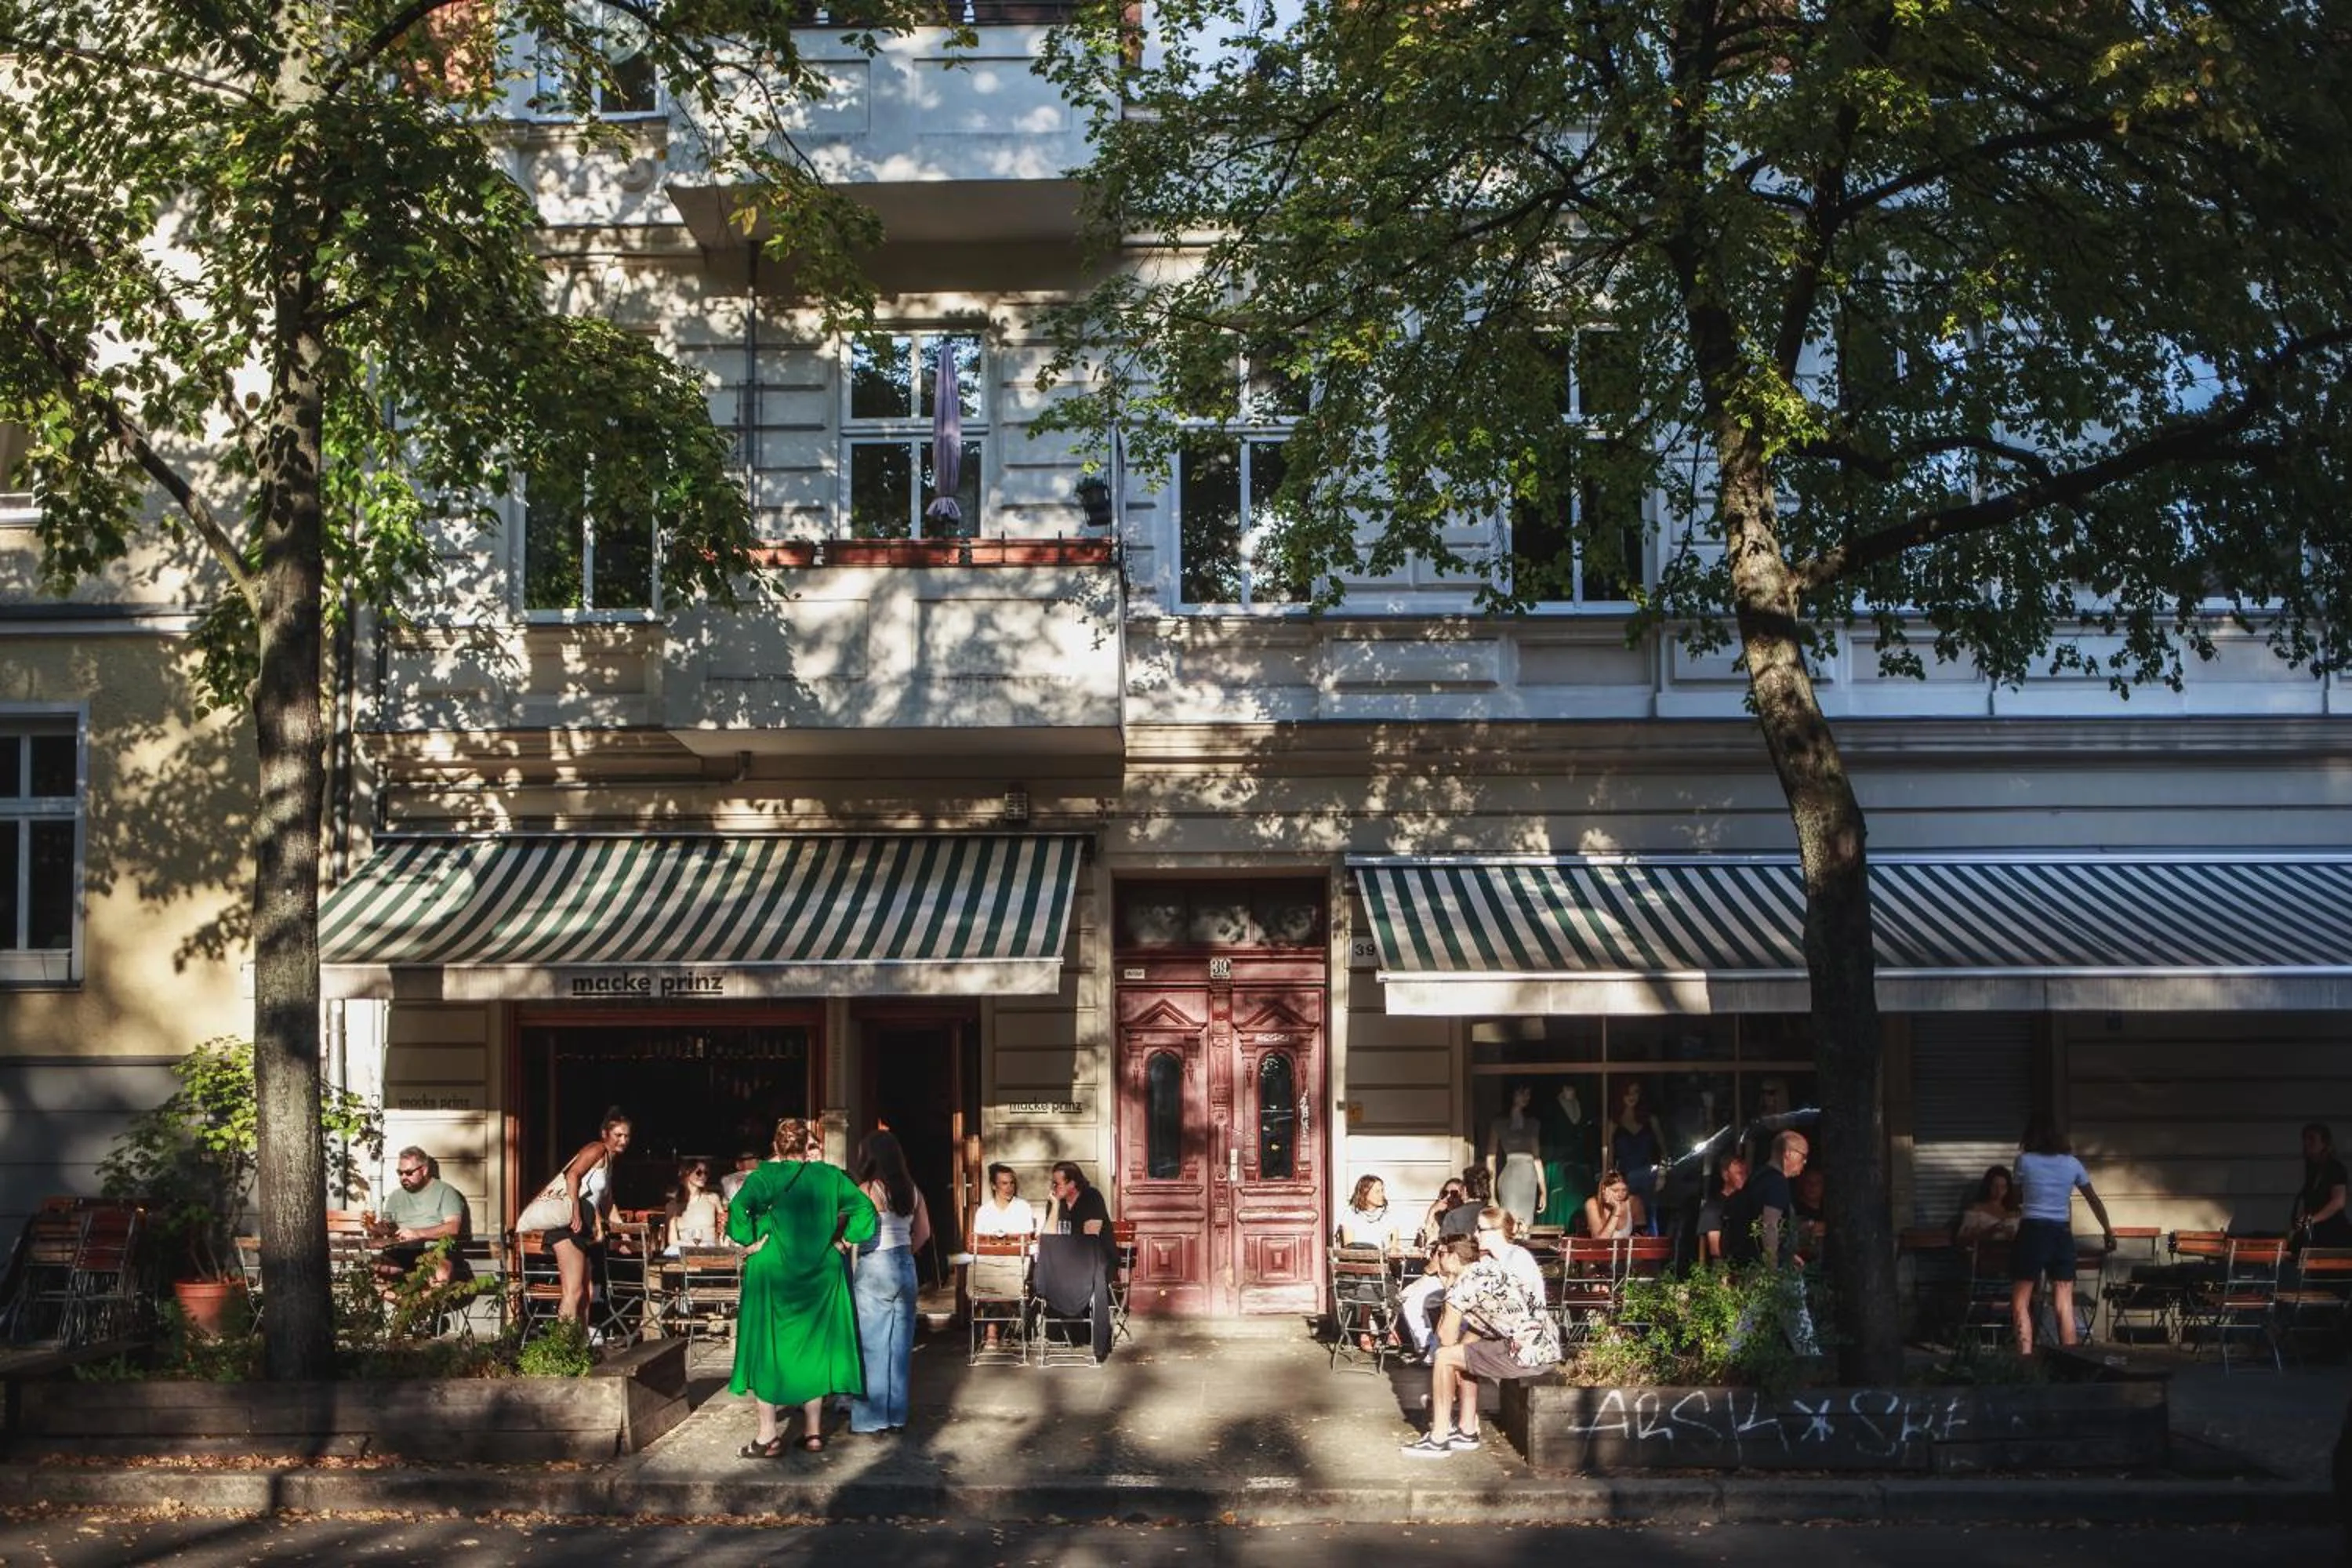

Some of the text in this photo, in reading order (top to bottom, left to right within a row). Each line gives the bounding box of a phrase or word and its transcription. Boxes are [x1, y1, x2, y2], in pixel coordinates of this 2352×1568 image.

[1355, 943, 1376, 956] 39
[572, 971, 723, 996] macke prinz
[1009, 1097, 1048, 1113] macke
